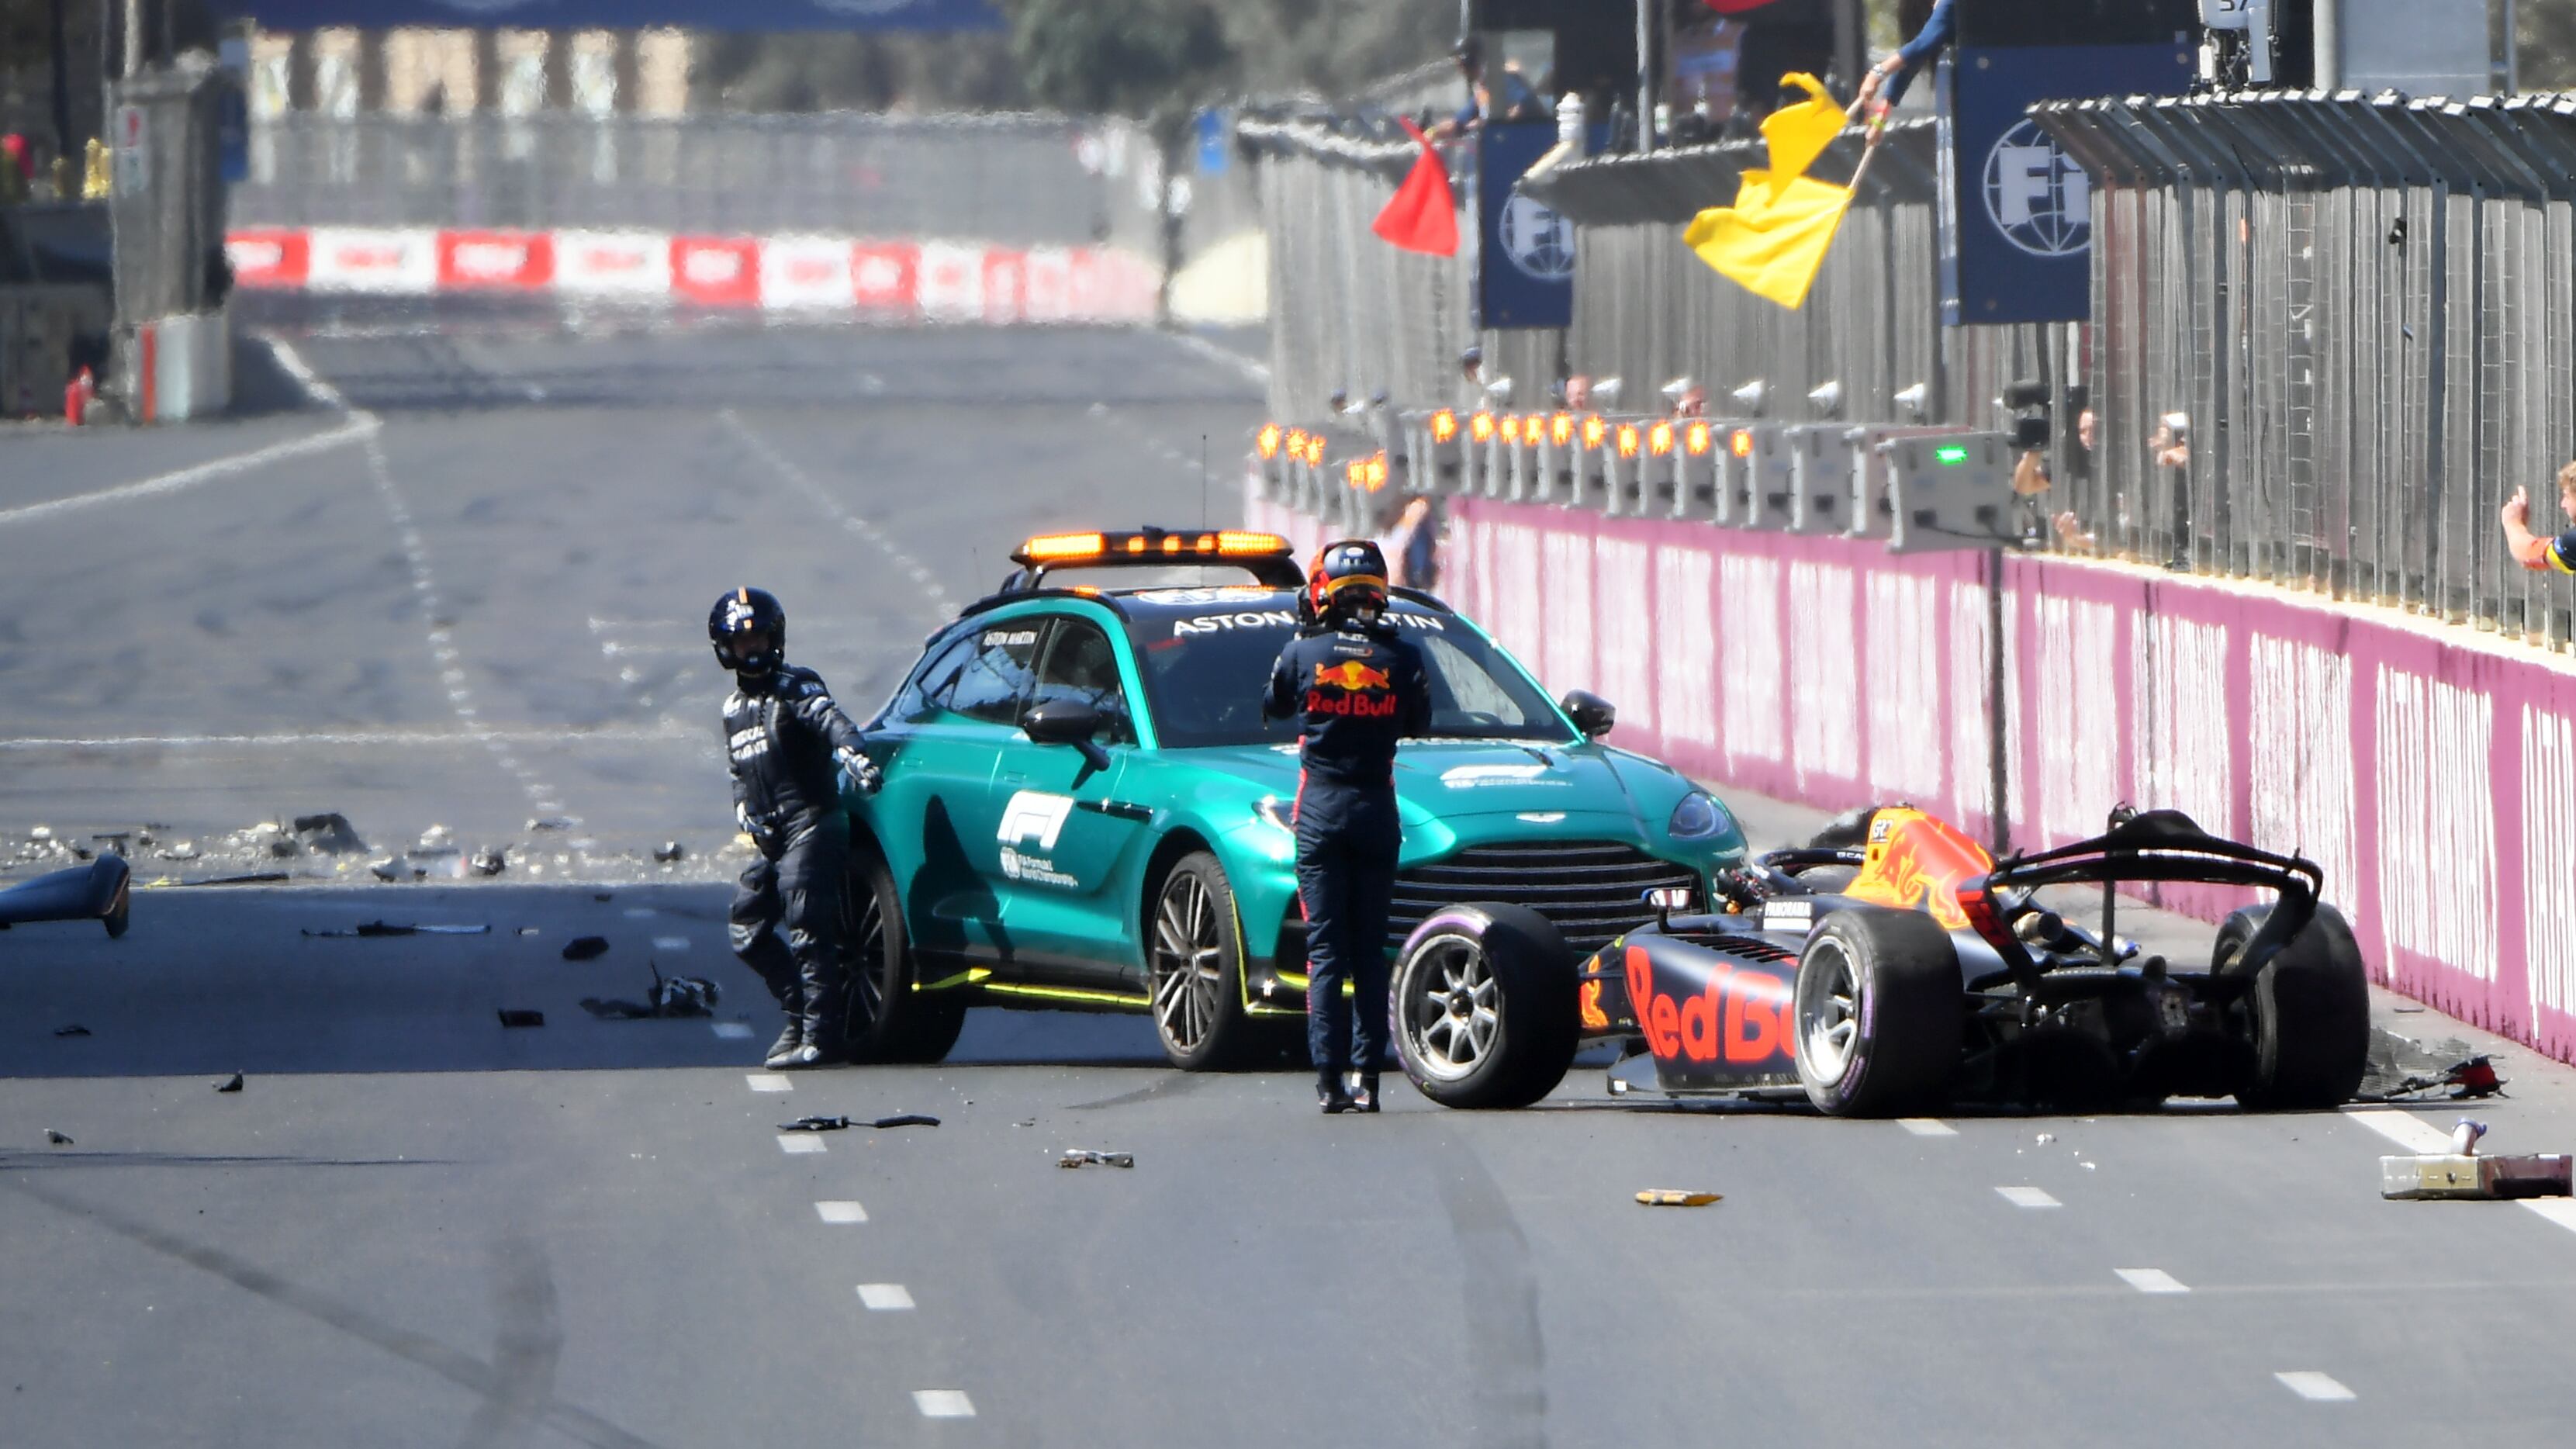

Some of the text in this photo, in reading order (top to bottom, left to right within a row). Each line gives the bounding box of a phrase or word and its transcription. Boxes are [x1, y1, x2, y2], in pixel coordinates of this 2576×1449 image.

[1173, 610, 1295, 639] ASTON
[1306, 690, 1396, 717] Red Bull
[1625, 946, 1732, 1061] Red
